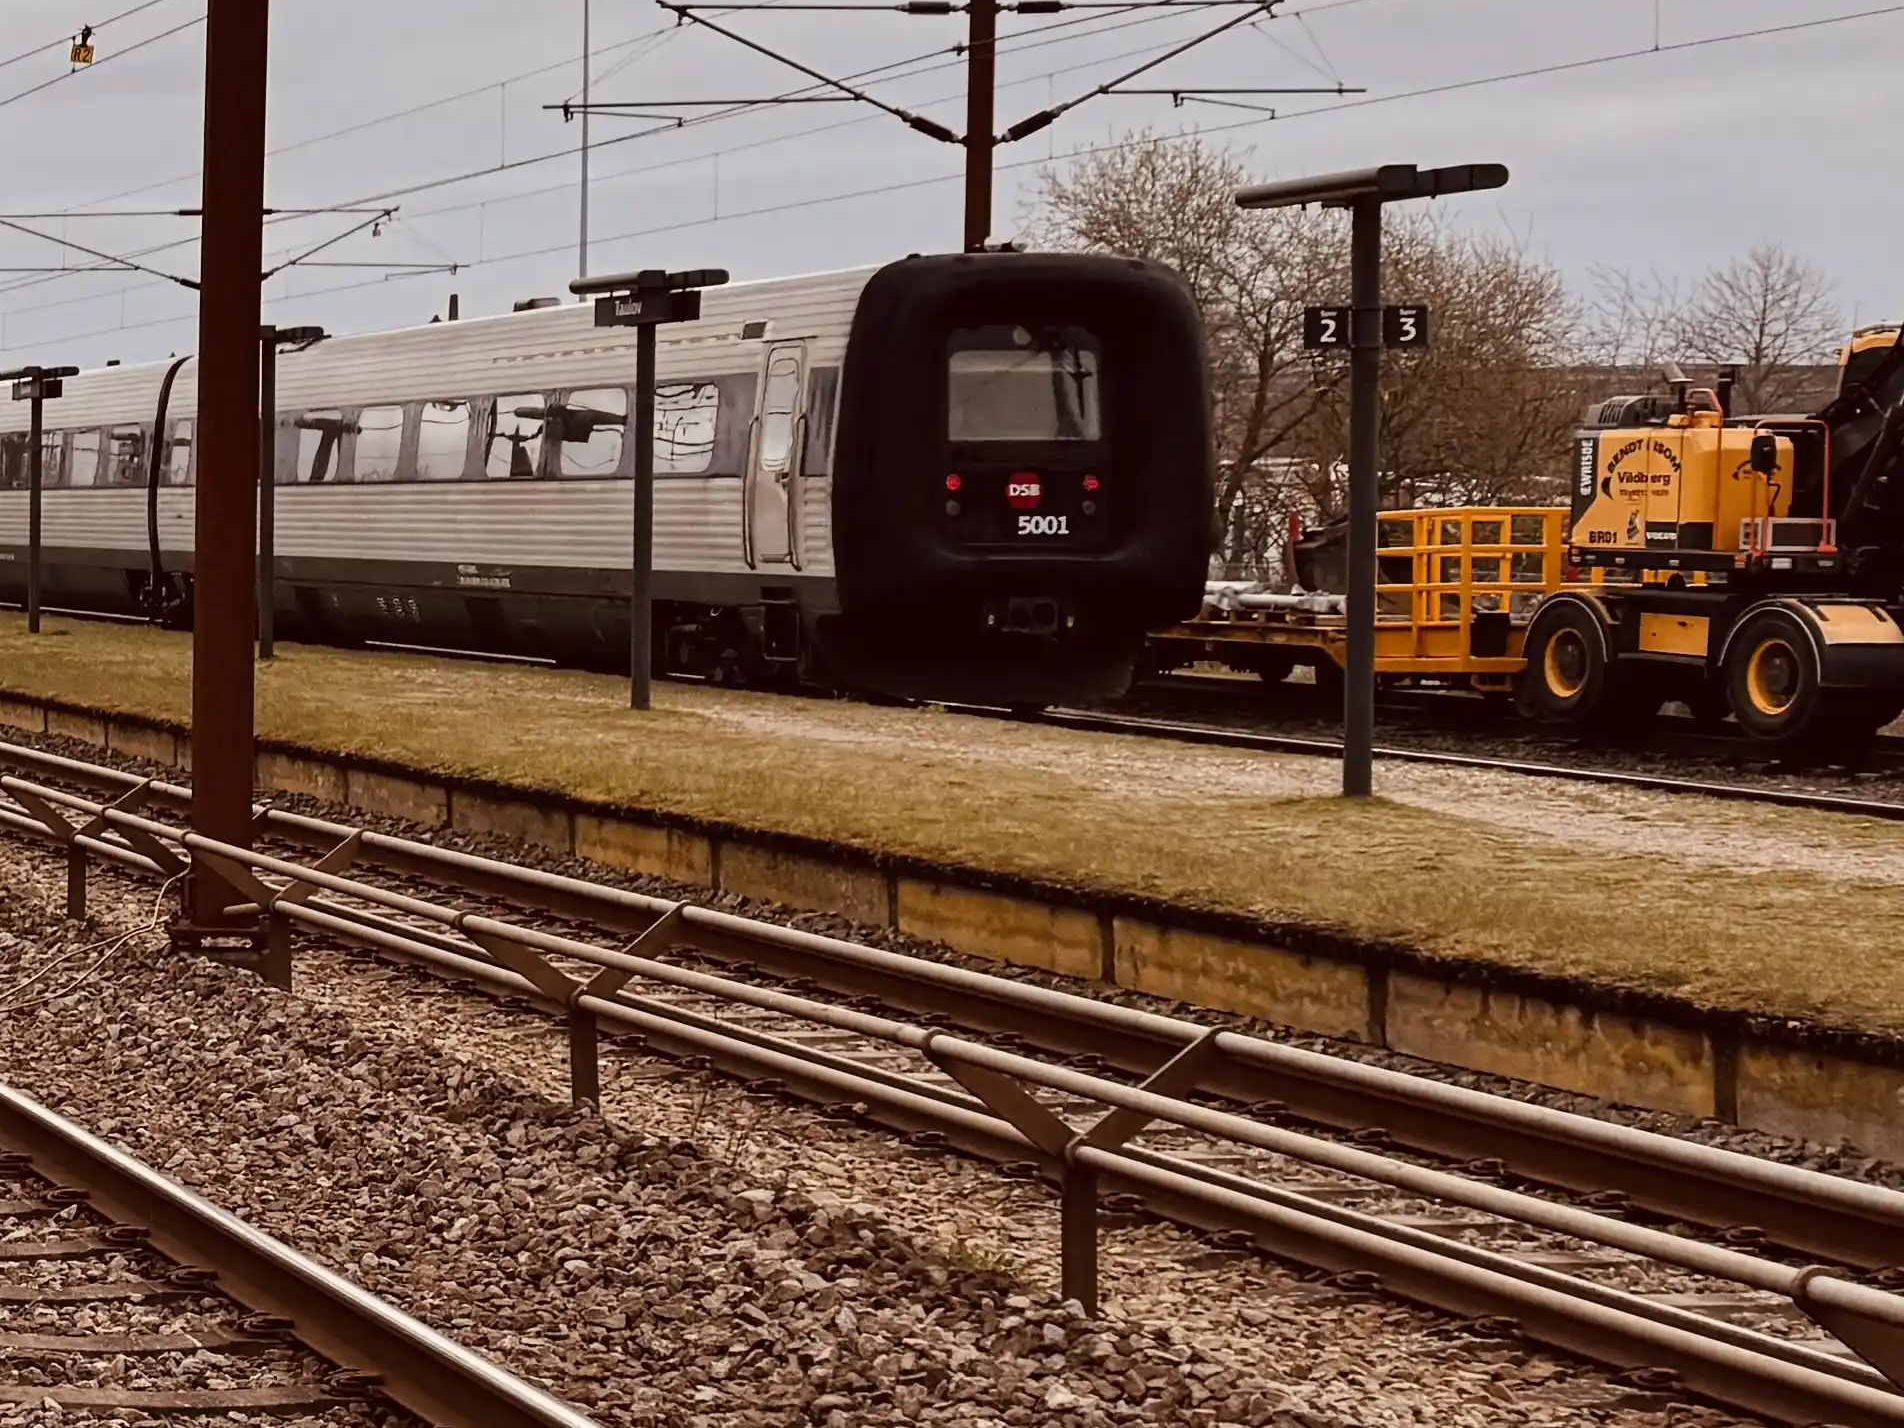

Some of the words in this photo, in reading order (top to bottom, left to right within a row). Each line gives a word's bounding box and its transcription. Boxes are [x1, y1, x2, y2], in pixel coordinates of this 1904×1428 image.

[1319, 318, 1337, 343] 2
[1399, 317, 1417, 342] 3
[1617, 471, 1672, 486] Vildberg
[1009, 483, 1041, 496] DSB
[1018, 515, 1070, 535] 5001
